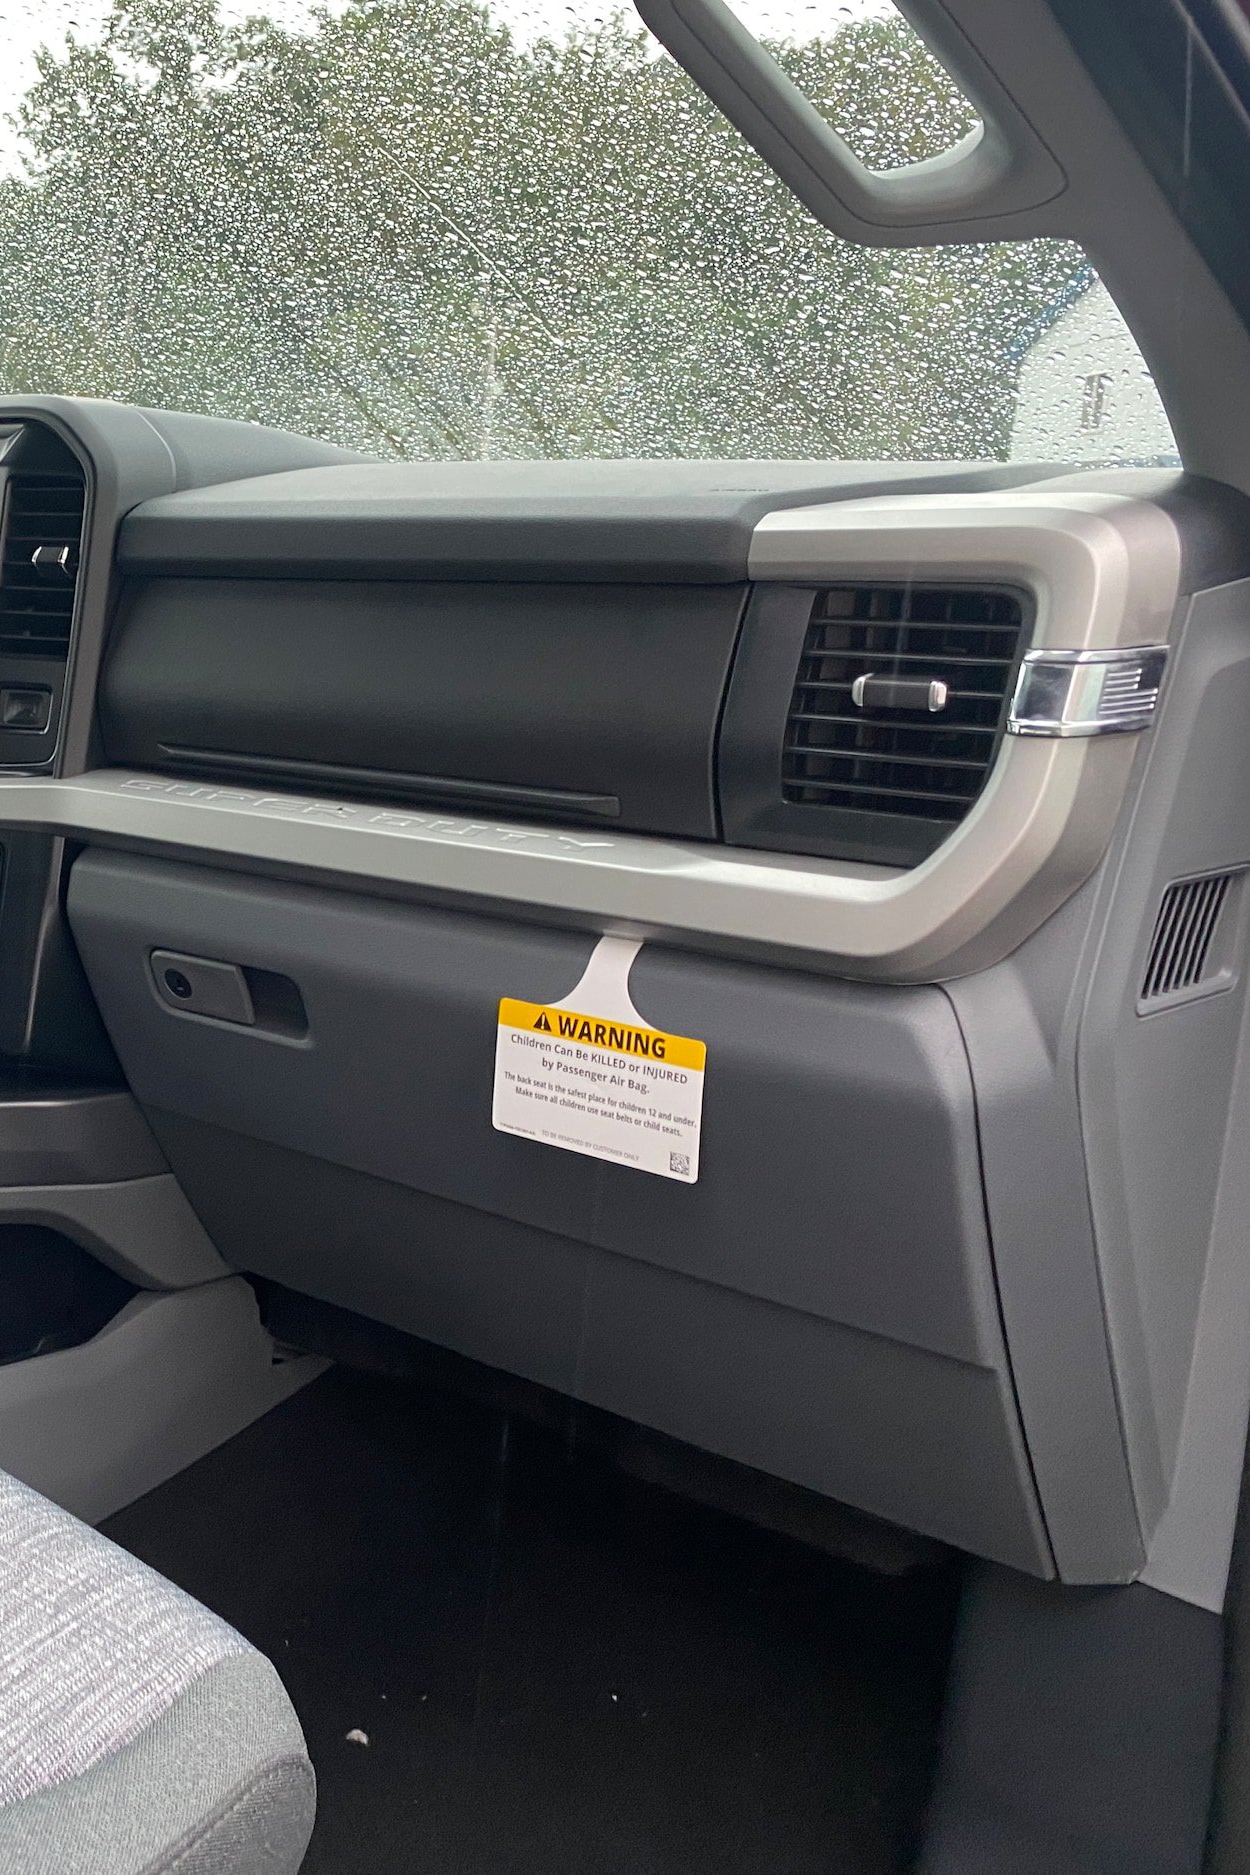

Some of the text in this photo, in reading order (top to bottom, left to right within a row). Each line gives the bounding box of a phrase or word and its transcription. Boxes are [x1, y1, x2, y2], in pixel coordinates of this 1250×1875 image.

[120, 778, 616, 851] SUPER DUTY
[511, 1033, 688, 1085] Children Can Be KILLED or INJURED
[559, 1015, 666, 1059] WARNING
[517, 1073, 532, 1085] back
[533, 1079, 547, 1089] seat
[555, 1084, 567, 1094] the
[568, 1088, 587, 1100] safest
[589, 1093, 606, 1105] place
[619, 1100, 647, 1115] children
[658, 1111, 672, 1122] and
[542, 1057, 650, 1095] by Passenger Air Bag.
[516, 1086, 533, 1098] Make
[535, 1092, 549, 1102] sure
[560, 1097, 586, 1112] children
[587, 1106, 599, 1116] use
[601, 1109, 615, 1120] seat
[616, 1111, 633, 1124] belts
[644, 1120, 661, 1131] child
